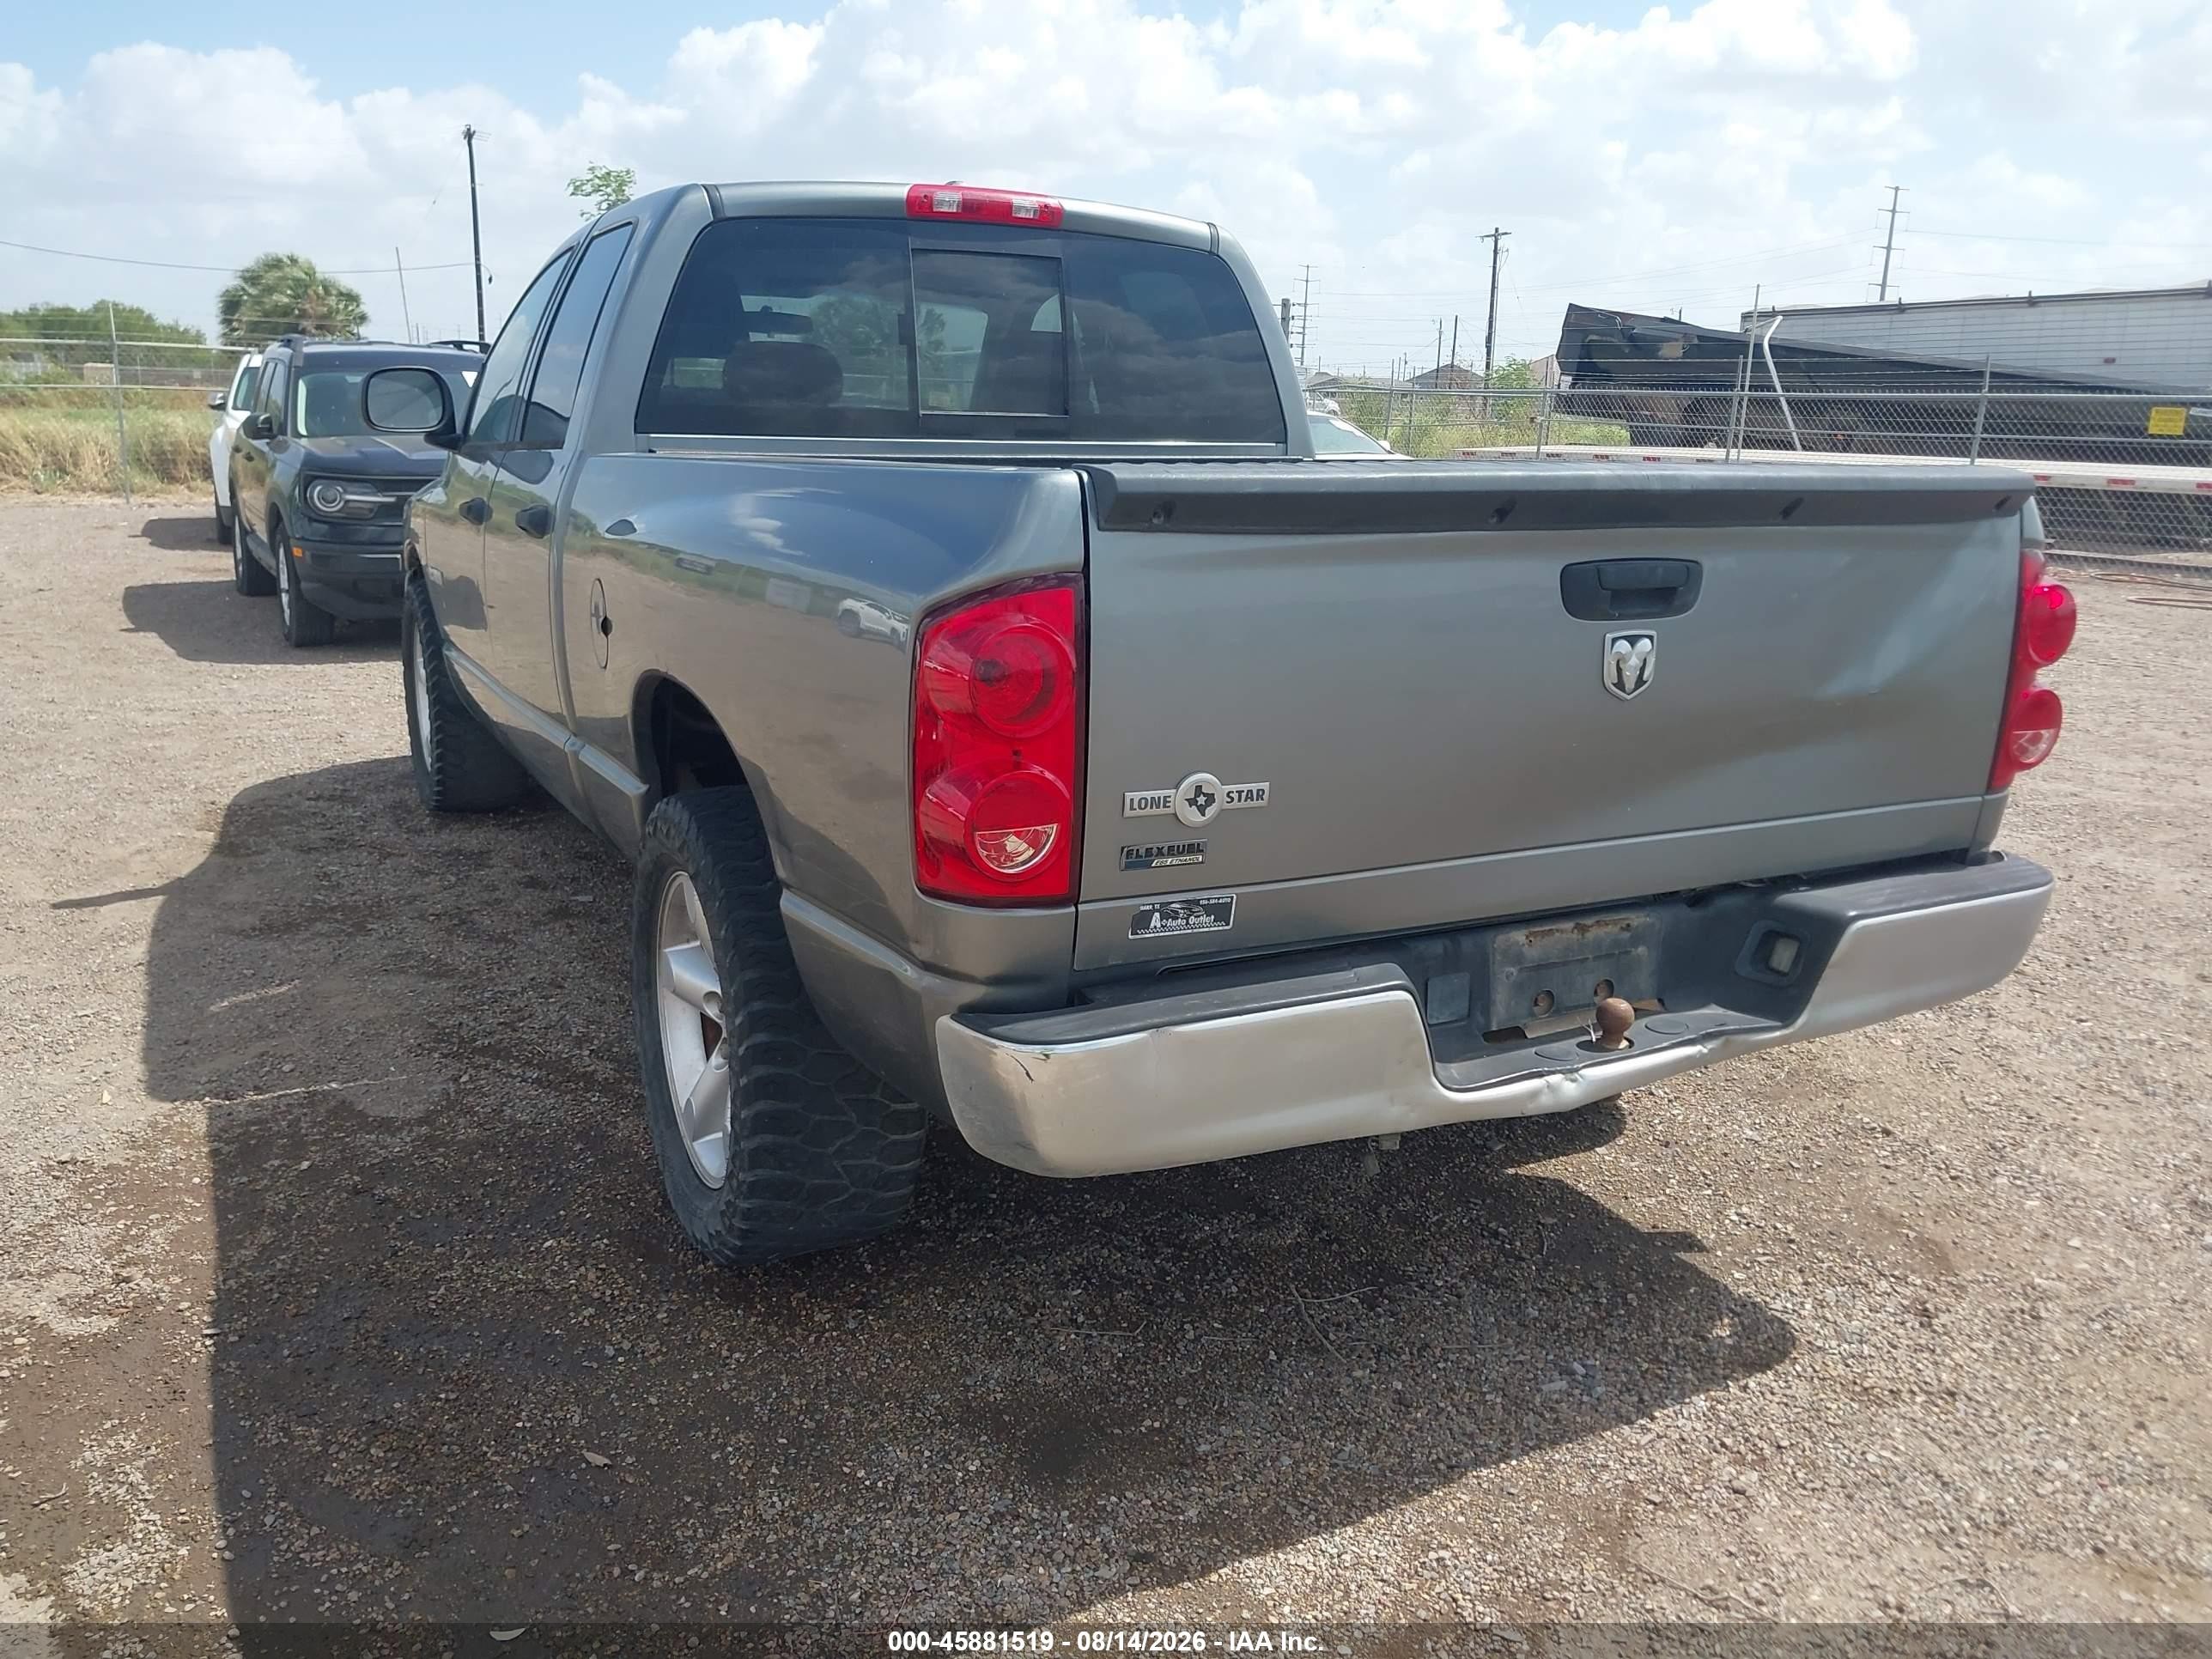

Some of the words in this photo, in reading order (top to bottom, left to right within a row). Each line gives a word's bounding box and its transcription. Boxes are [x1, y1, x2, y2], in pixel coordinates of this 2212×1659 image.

[1129, 795, 1172, 811] LONE
[1225, 788, 1266, 804] STAR
[1188, 914, 1215, 926] Outlet
